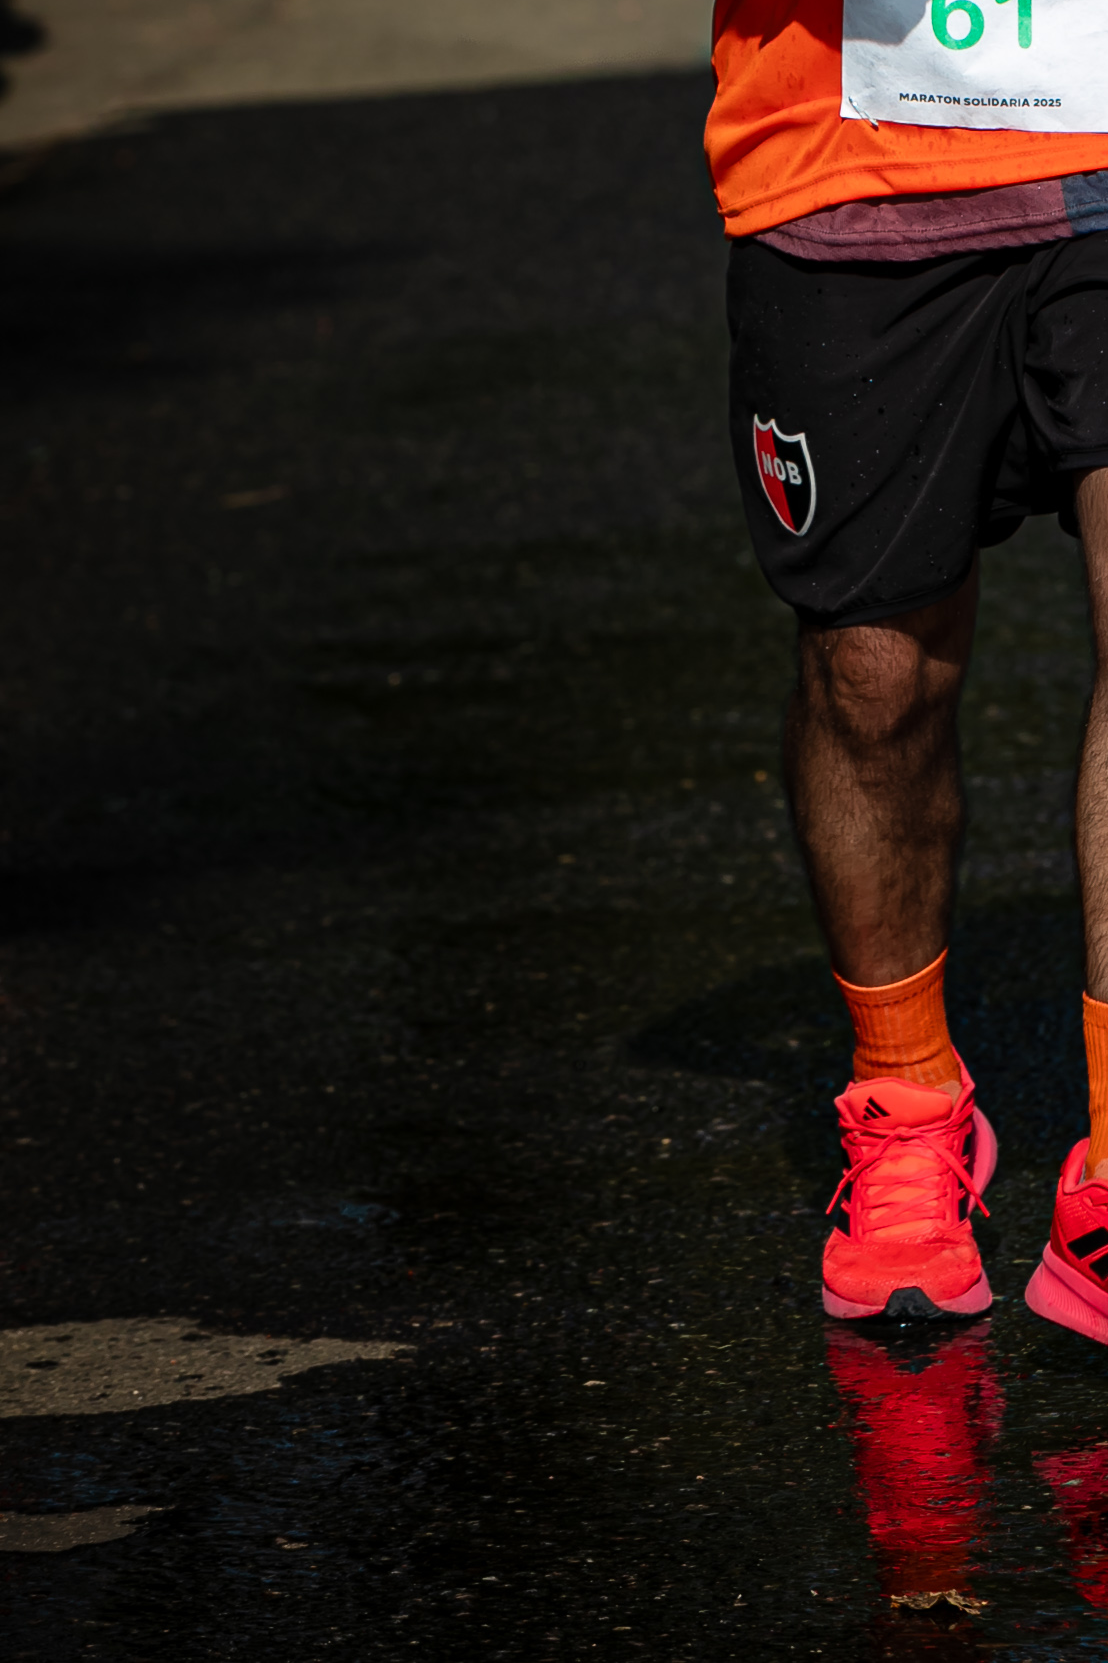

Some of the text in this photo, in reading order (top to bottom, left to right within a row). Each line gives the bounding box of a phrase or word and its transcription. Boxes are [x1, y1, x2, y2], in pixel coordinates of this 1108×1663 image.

[899, 92, 1062, 108] MARATON SOLIDARIA 2025
[760, 450, 803, 486] NOB
